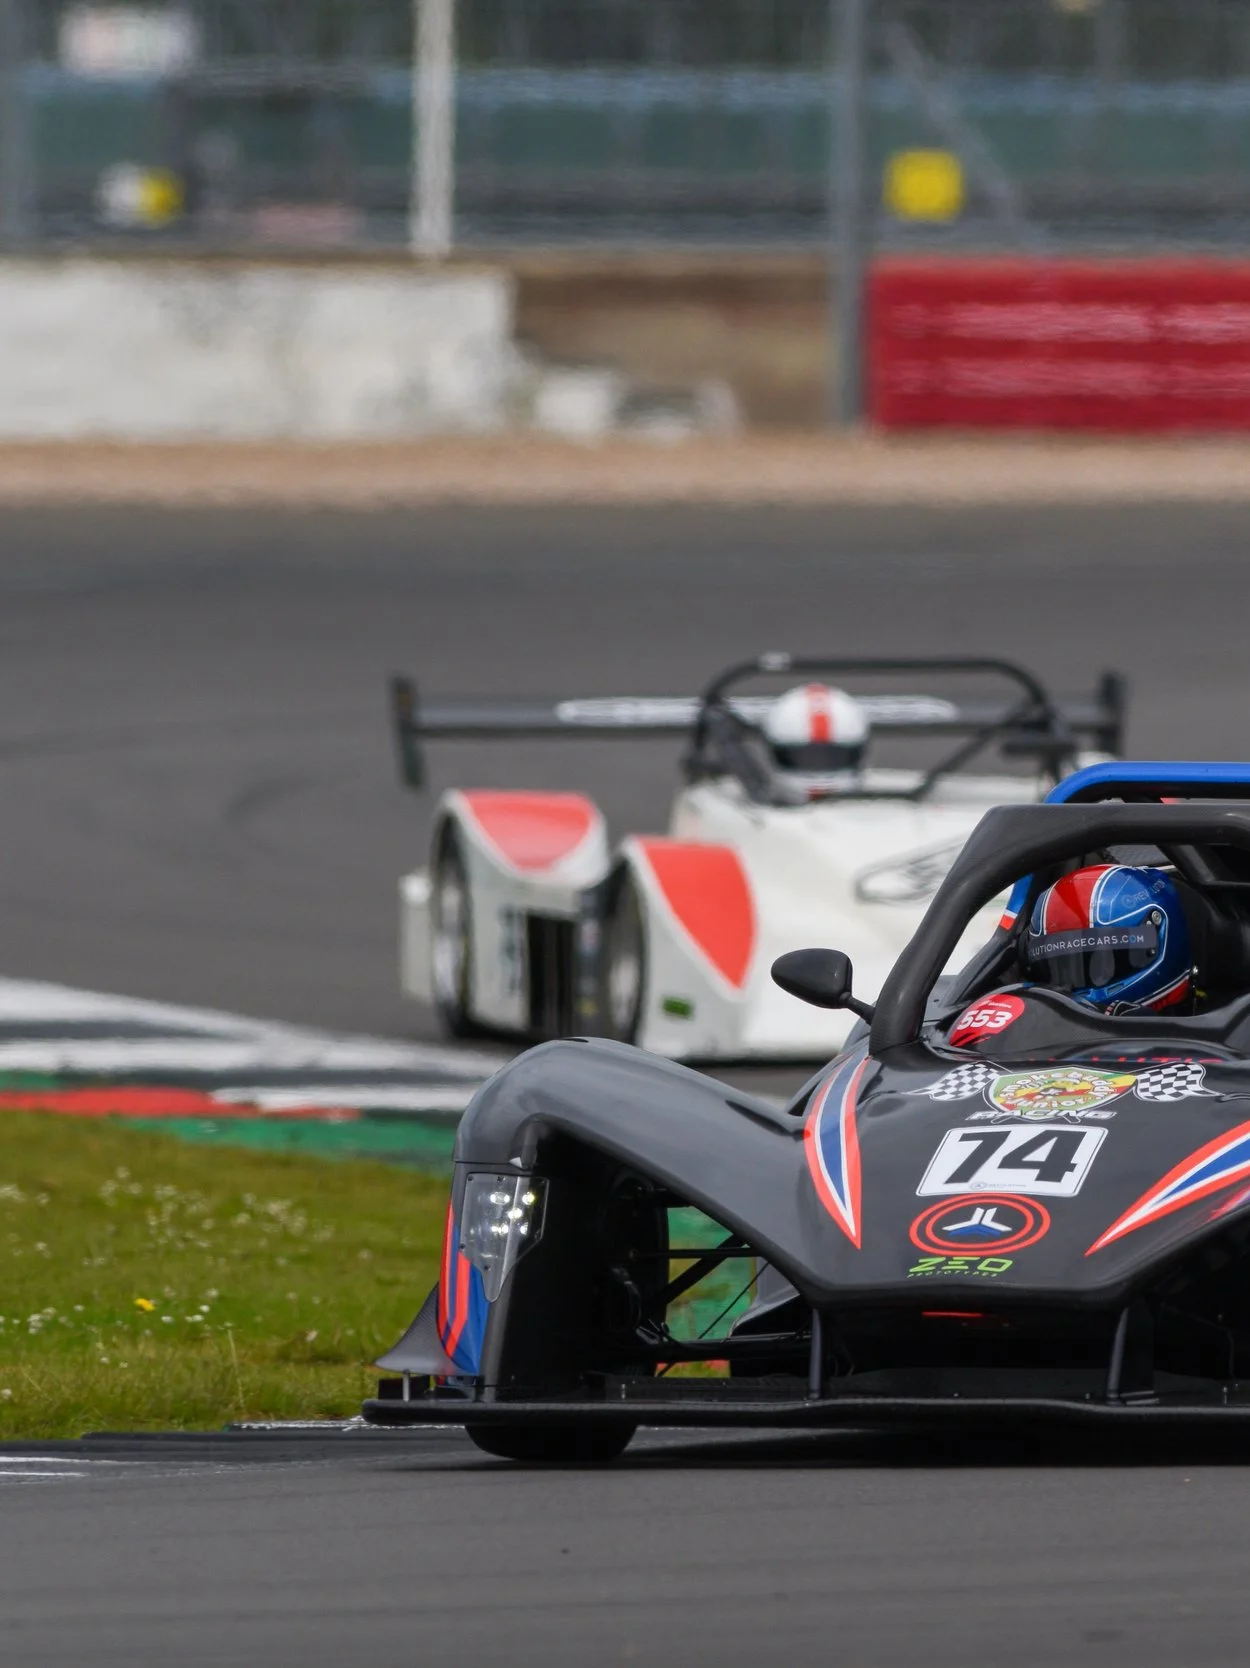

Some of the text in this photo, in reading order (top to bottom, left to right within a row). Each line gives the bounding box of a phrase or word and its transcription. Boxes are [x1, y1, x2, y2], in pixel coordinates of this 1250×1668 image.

[957, 1009, 1013, 1030] 553
[965, 1109, 1118, 1120] RACING
[943, 1129, 1088, 1184] 14
